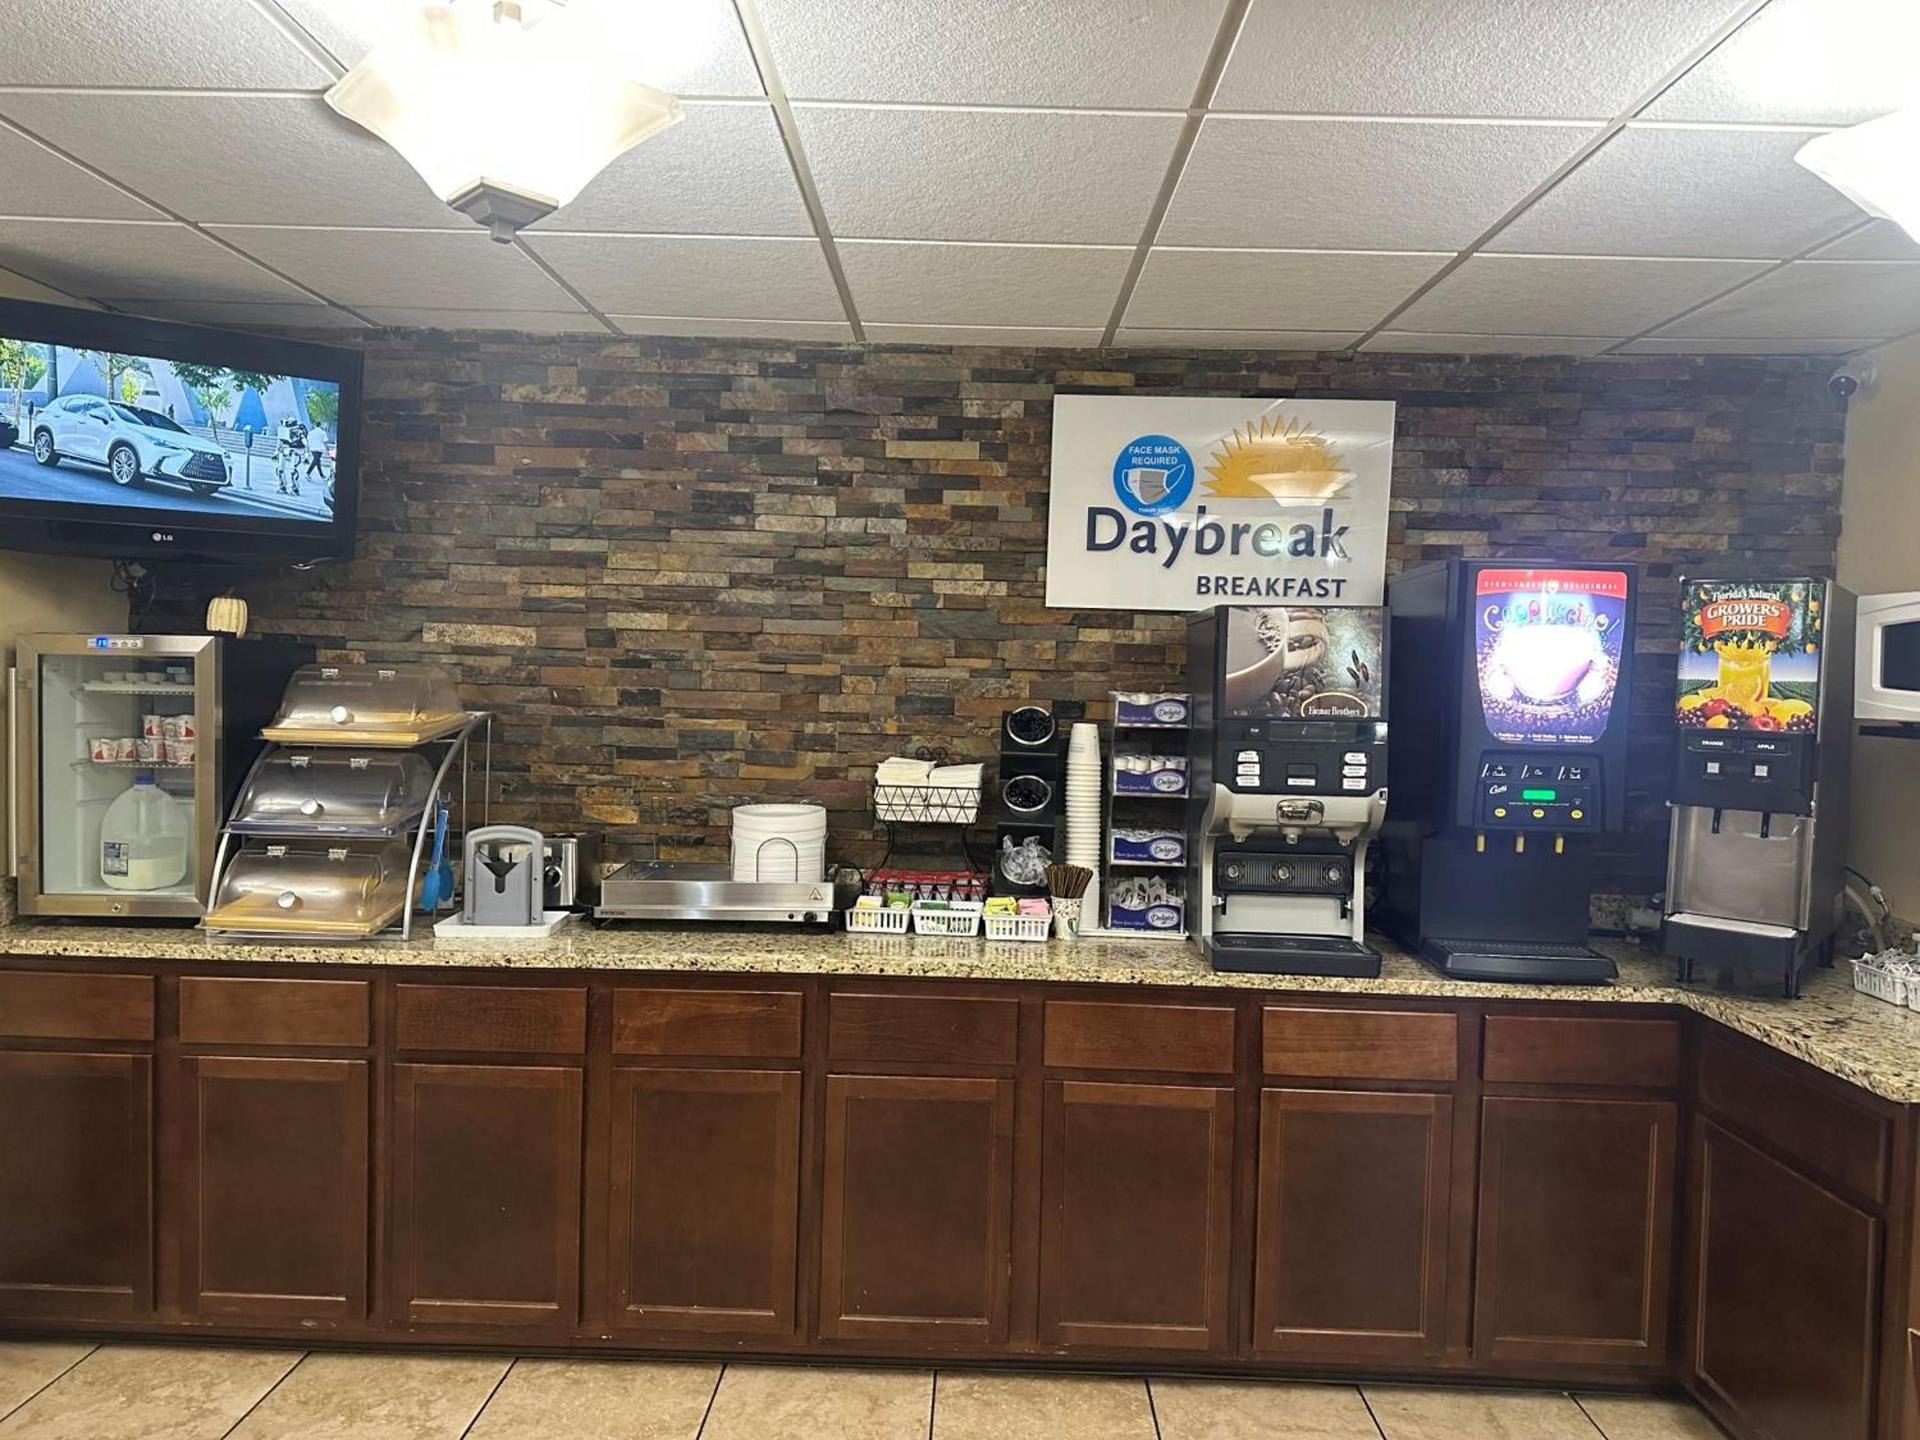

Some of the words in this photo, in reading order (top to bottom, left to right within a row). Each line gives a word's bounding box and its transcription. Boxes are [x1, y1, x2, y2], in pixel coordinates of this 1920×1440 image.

[1128, 446, 1153, 454] FACE
[1154, 446, 1181, 454] MASK
[1131, 456, 1178, 464] REQUIRED
[1086, 505, 1349, 568] Daybreak
[1197, 575, 1346, 598] BREAKFAST
[1722, 613, 1768, 627] PRIDE
